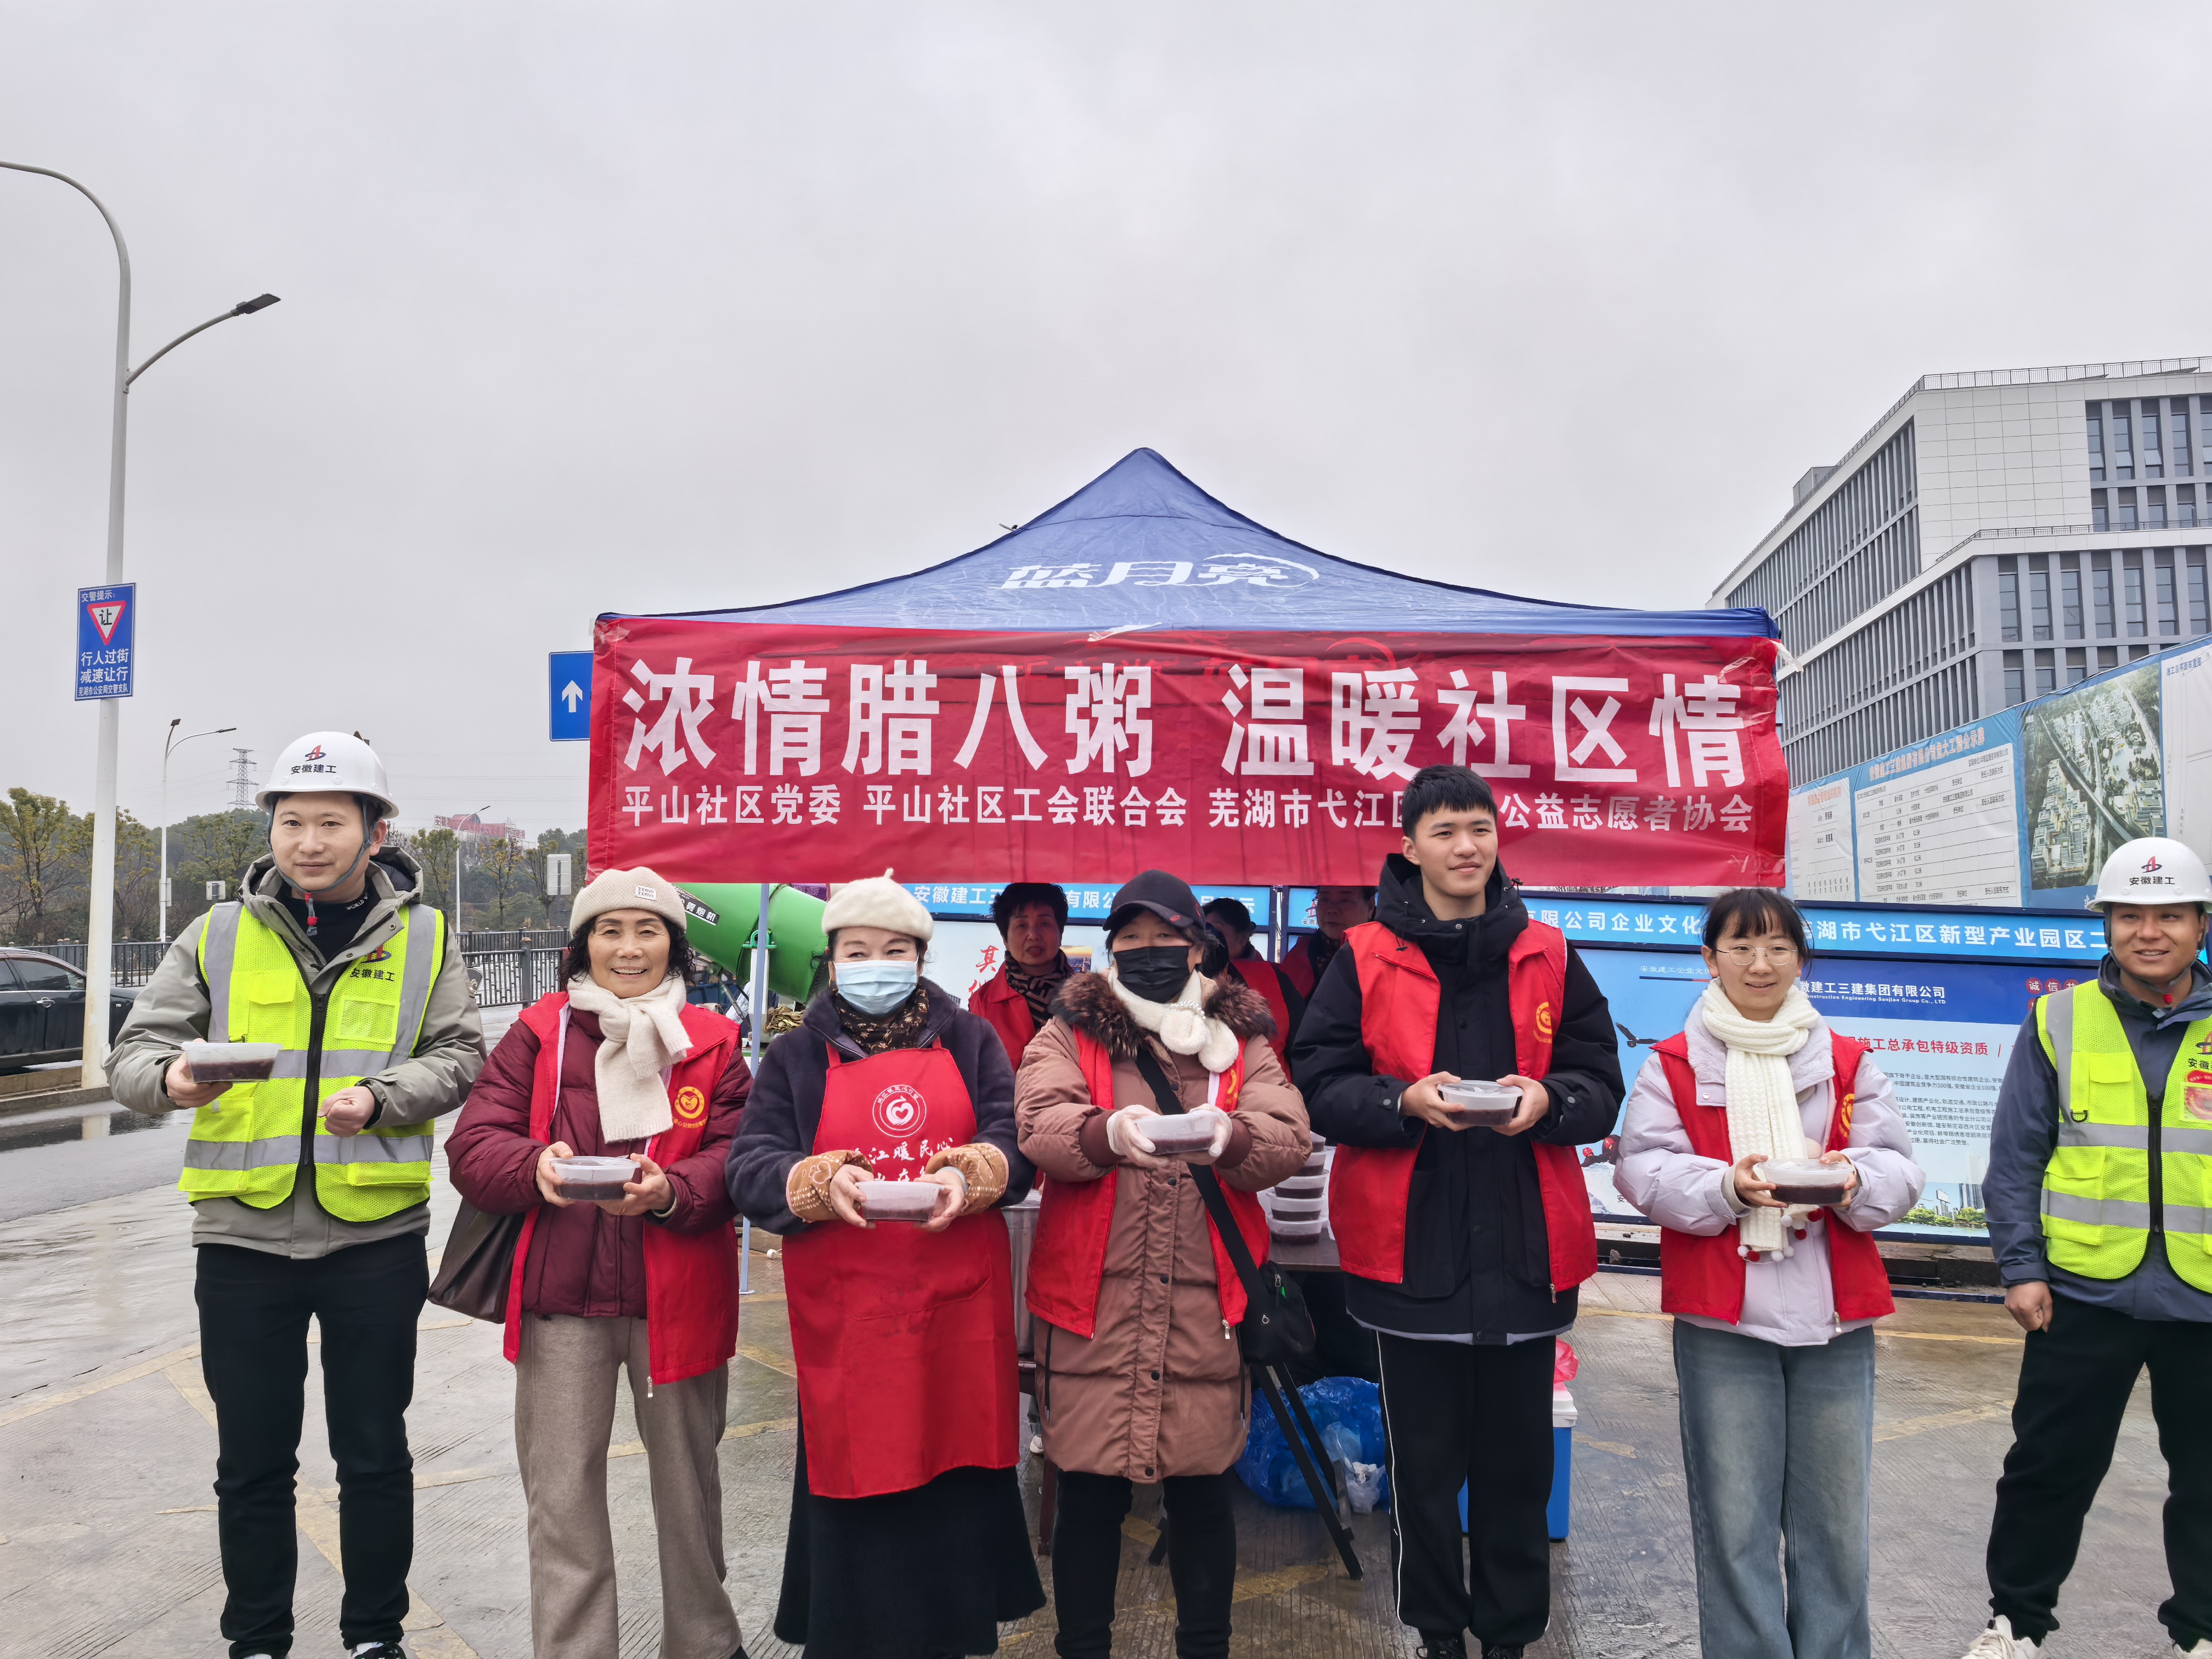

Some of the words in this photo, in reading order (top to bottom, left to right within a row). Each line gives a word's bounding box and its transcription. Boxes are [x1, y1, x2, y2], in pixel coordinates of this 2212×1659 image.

[989, 553, 1320, 589] 蓝月亮
[99, 608, 112, 625] 让
[81, 648, 129, 666] 行人过街
[80, 666, 129, 684] 减速让行
[78, 683, 129, 697] 芜湖市公安局交警支队
[622, 657, 1152, 778] 浓情腊八粥
[1221, 663, 1746, 788] 温暖社区情
[291, 764, 337, 774] 安徽建工
[622, 783, 841, 826] 平山社区党委
[864, 784, 1186, 828] 平山社区工会联合会
[1209, 788, 1754, 833] 芜湖市弋江公益志愿者协会
[2129, 875, 2175, 886] 安徽建工
[346, 900, 365, 910] WORLD
[681, 898, 716, 922] 雾炮机
[350, 967, 395, 982] 安徽建工
[2188, 1058, 2212, 1070] 安徽
